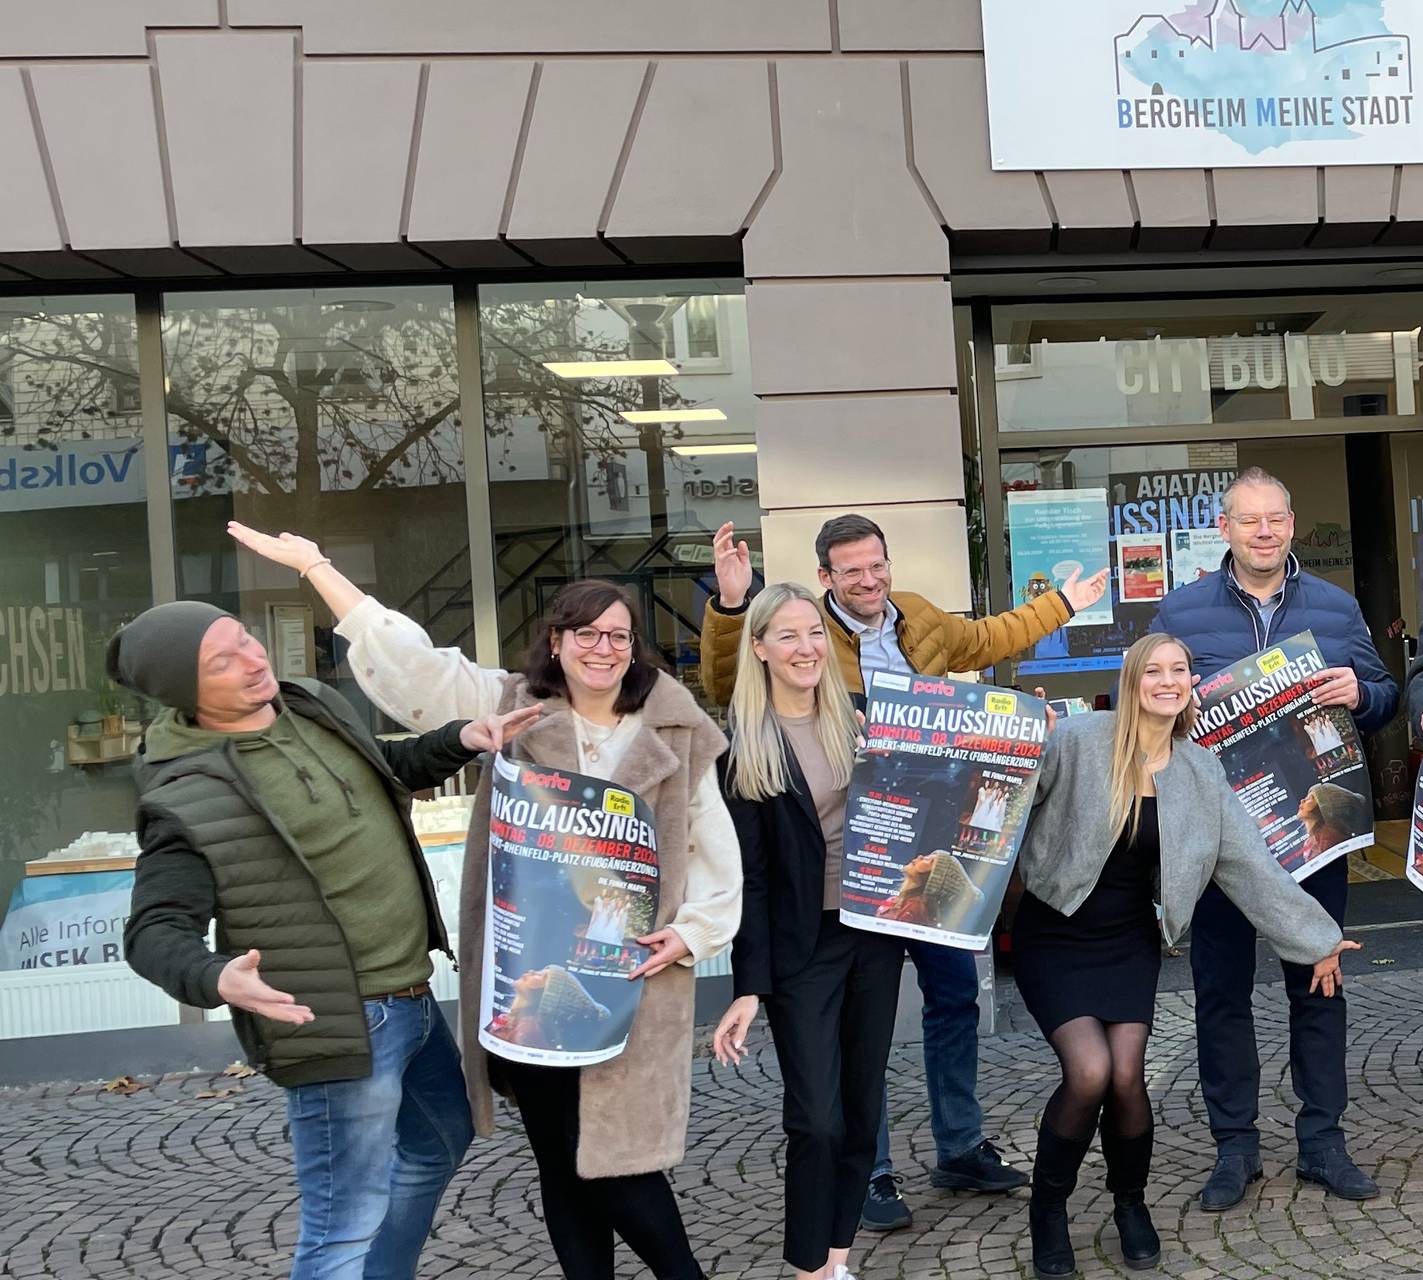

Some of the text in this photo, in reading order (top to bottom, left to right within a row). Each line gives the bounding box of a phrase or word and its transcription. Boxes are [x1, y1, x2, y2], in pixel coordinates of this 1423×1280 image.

[1117, 96, 1413, 129] BERGHEIM MEINE STADT
[912, 680, 956, 697] porta
[1199, 673, 1234, 698] porta
[1256, 684, 1305, 717] DEZEMBER
[870, 701, 1046, 743] NIKOLAUSSINGEN
[1209, 715, 1278, 754] ERT-RHEINFELD-PLATZ
[868, 725, 922, 742] SONNTAG
[954, 736, 1013, 753] DEZEMBER
[1014, 742, 1041, 757] 2024
[521, 770, 571, 791] porta
[610, 794, 630, 805] Radio
[563, 838, 630, 858] DEZEMBER
[20, 926, 49, 951] Alle
